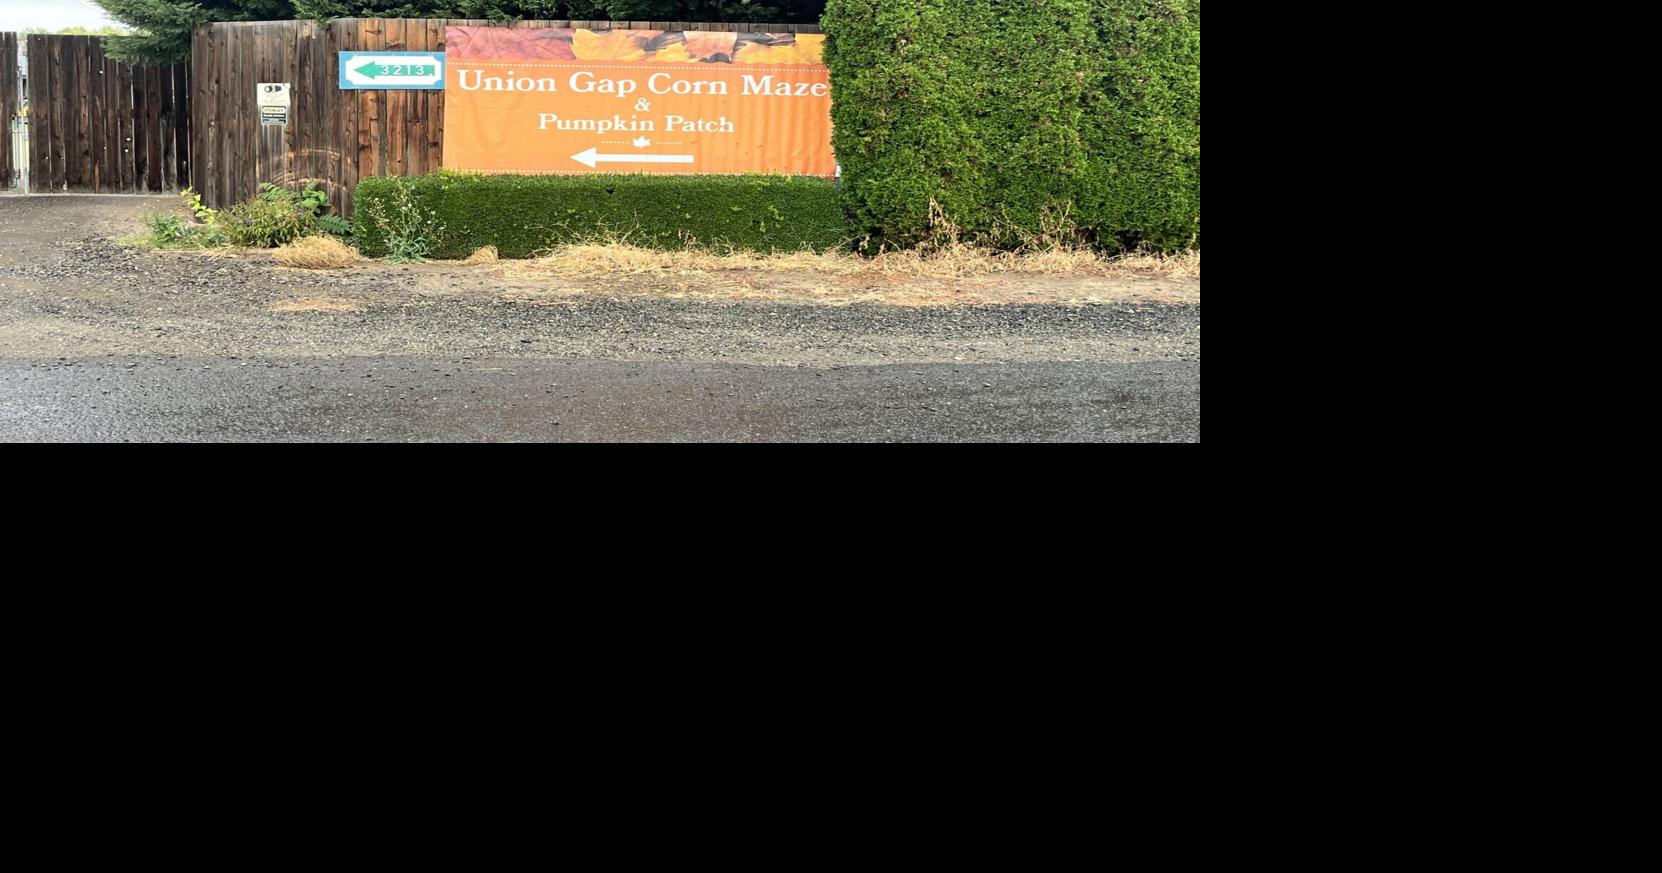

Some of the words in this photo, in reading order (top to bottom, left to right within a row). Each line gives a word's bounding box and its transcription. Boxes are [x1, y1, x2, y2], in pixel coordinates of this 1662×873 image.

[380, 65, 424, 76] 3213
[456, 69, 557, 92] Union
[568, 71, 637, 98] Gap
[647, 72, 728, 95] Corn
[740, 74, 828, 97] Maze
[634, 97, 651, 112] &
[538, 113, 654, 134] Pumpkin
[664, 115, 735, 133] Patch
